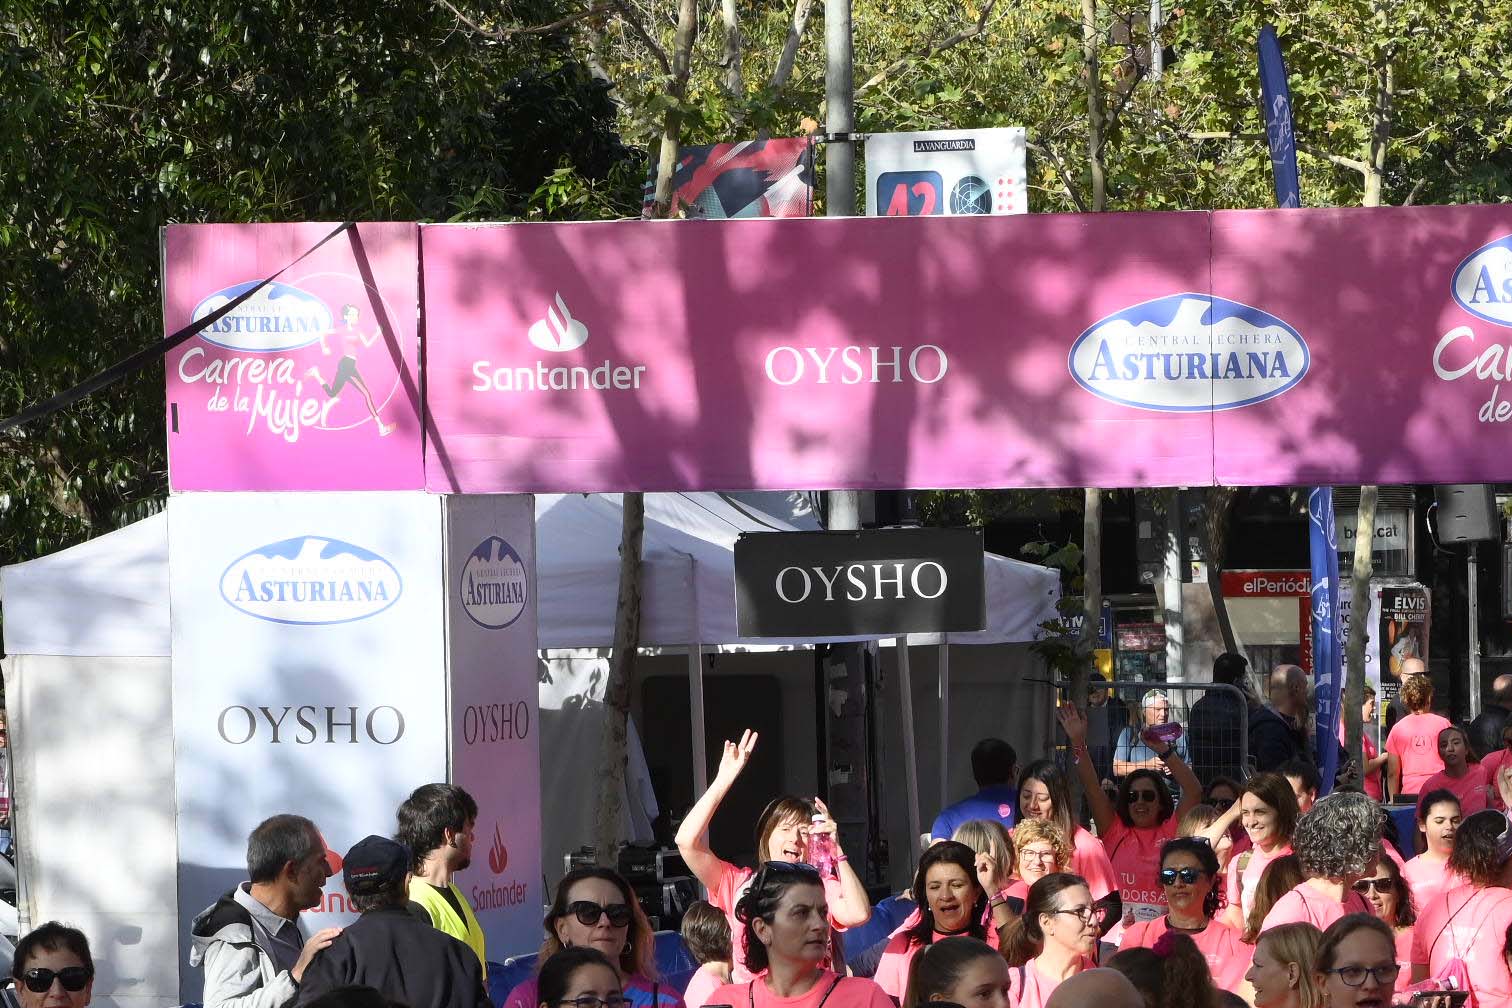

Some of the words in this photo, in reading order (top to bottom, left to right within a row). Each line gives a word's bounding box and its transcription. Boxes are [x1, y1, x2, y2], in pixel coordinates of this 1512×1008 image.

[925, 139, 974, 151] VANGUARDIA
[178, 346, 296, 385] Carrera
[472, 359, 647, 393] Santander
[764, 344, 949, 386] OYSHO
[1088, 339, 1291, 381] ASTURIANA
[207, 386, 229, 412] de
[233, 386, 249, 412] la
[246, 380, 340, 443] Mujer
[1478, 382, 1512, 424] de
[234, 569, 390, 602] ASTURIANA
[465, 561, 524, 606] ASTURIANA
[775, 560, 949, 604] OYSHO
[1394, 596, 1425, 609] ELVIS
[217, 704, 406, 745] OYSHO
[463, 700, 529, 745] OYSHO
[471, 881, 527, 913] Santander
[1121, 872, 1135, 885] TU
[1122, 888, 1169, 903] DORSA
